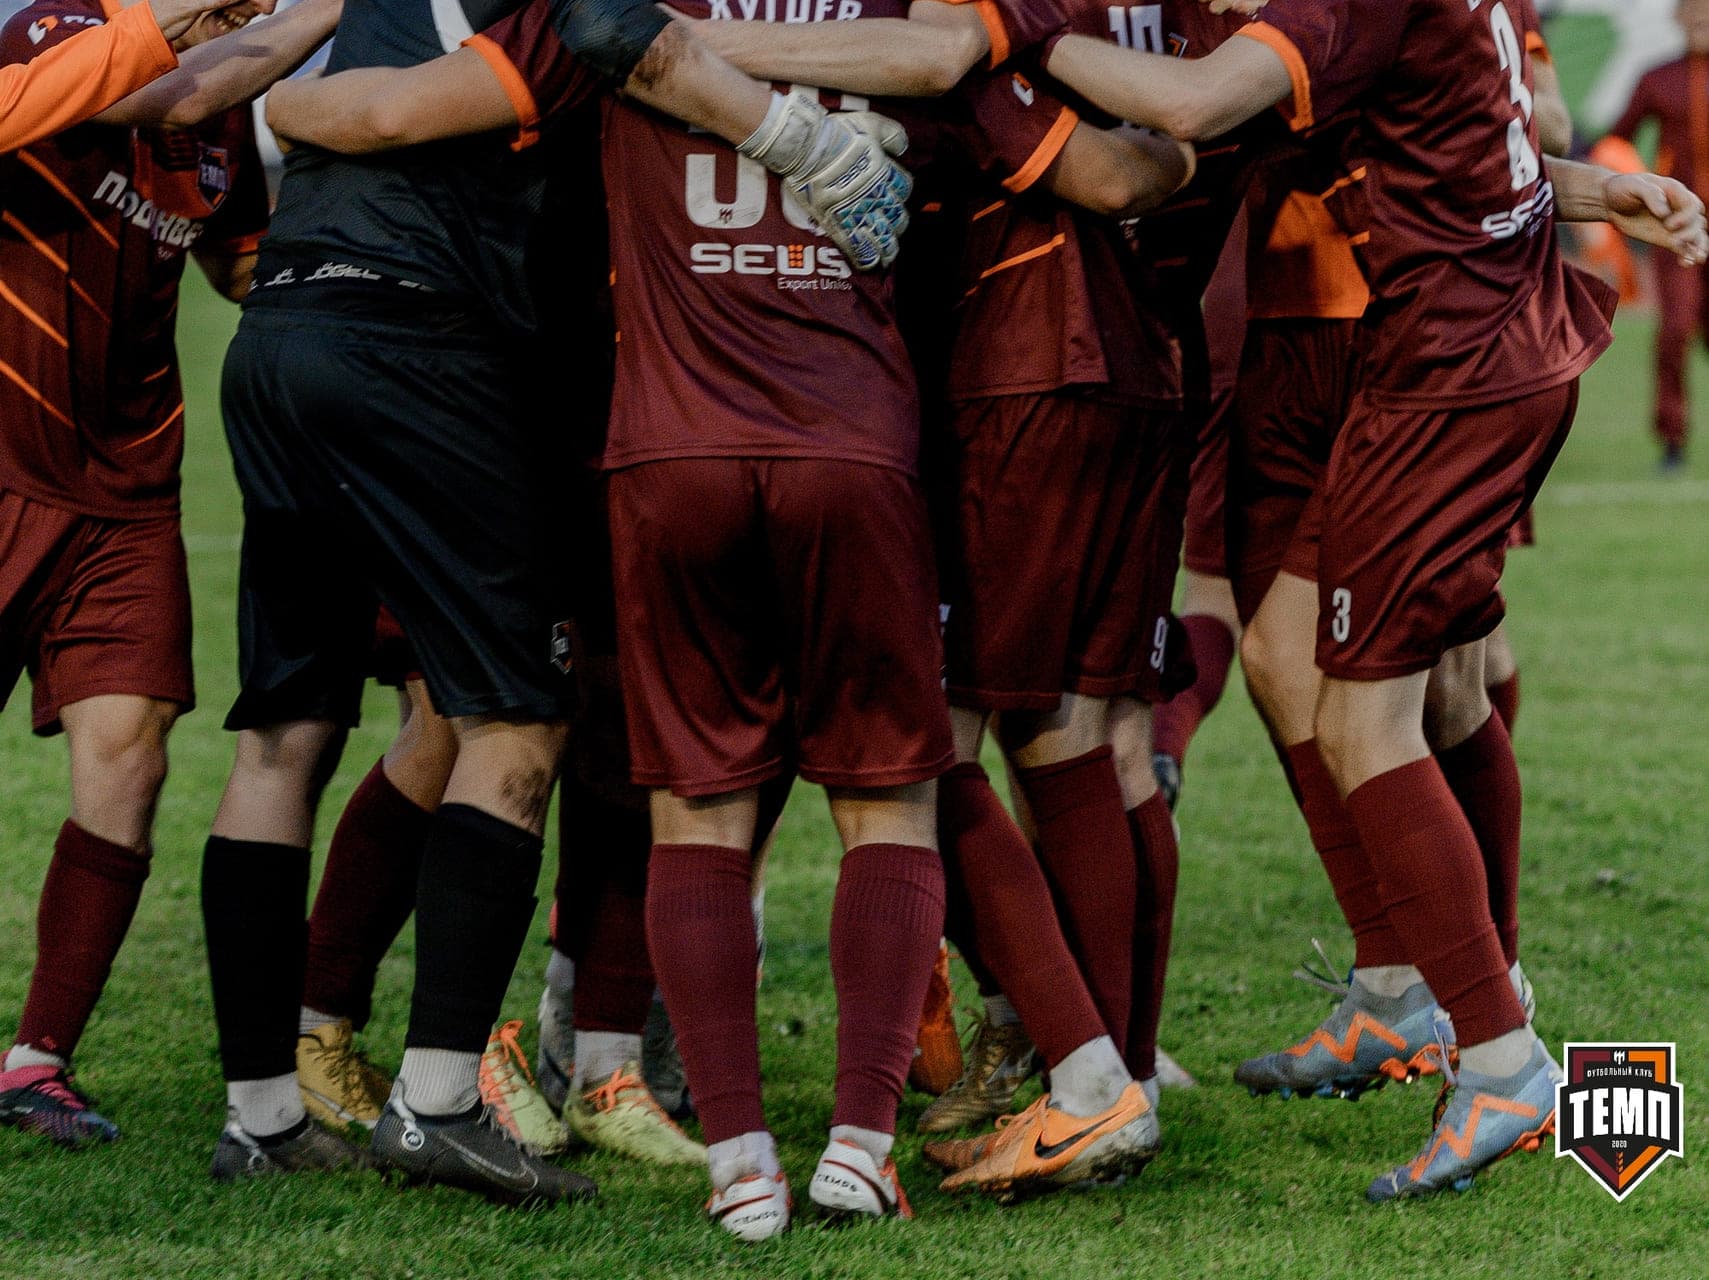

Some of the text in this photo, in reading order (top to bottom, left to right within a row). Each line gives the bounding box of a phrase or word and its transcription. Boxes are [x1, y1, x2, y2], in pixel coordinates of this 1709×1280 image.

[690, 242, 851, 279] SEUS
[777, 277, 818, 292] Export
[1332, 587, 1352, 644] 3
[1150, 616, 1169, 673] 9
